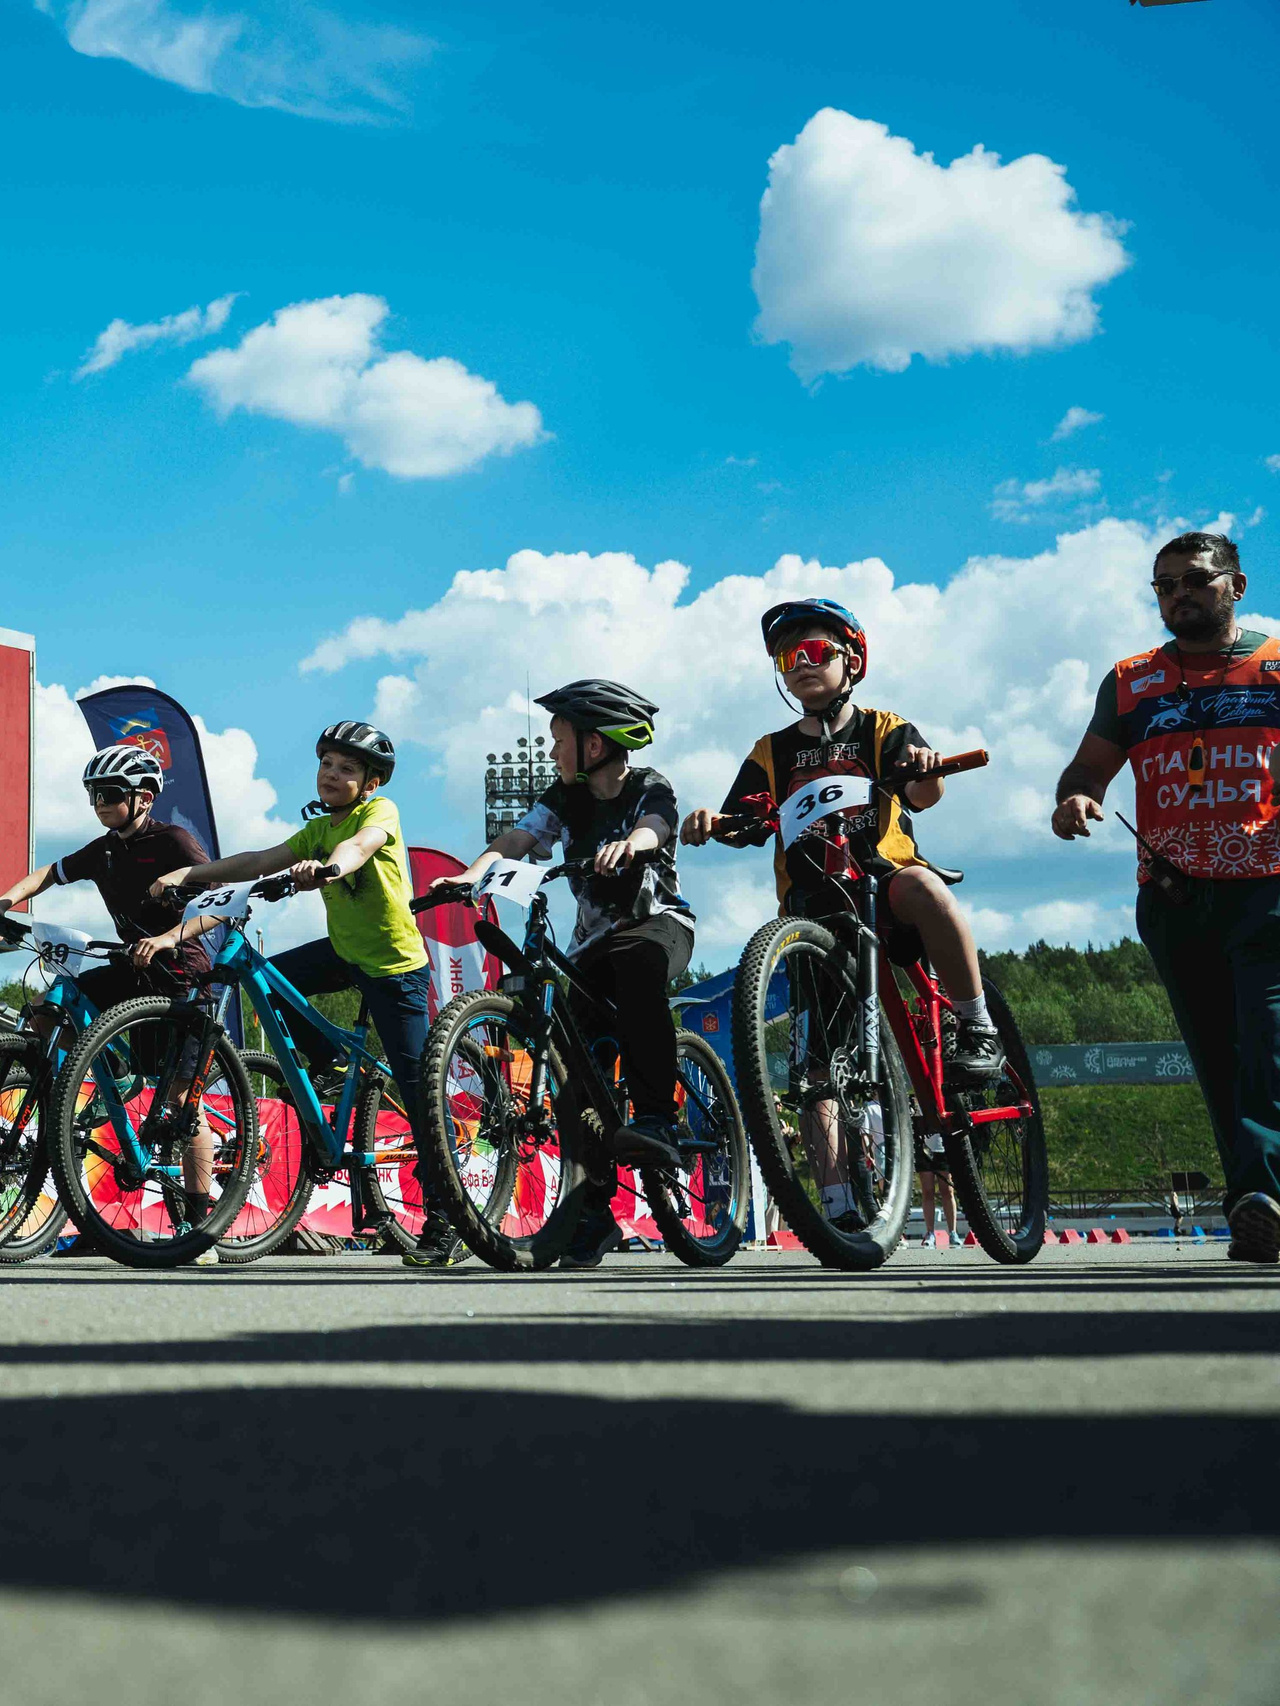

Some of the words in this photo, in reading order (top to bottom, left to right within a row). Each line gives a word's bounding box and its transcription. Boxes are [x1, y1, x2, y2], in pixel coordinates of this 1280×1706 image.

[795, 784, 844, 820] 36
[1156, 779, 1262, 811] СУДЬЯ
[197, 889, 235, 909] 53
[241, 1143, 252, 1176] RANGER
